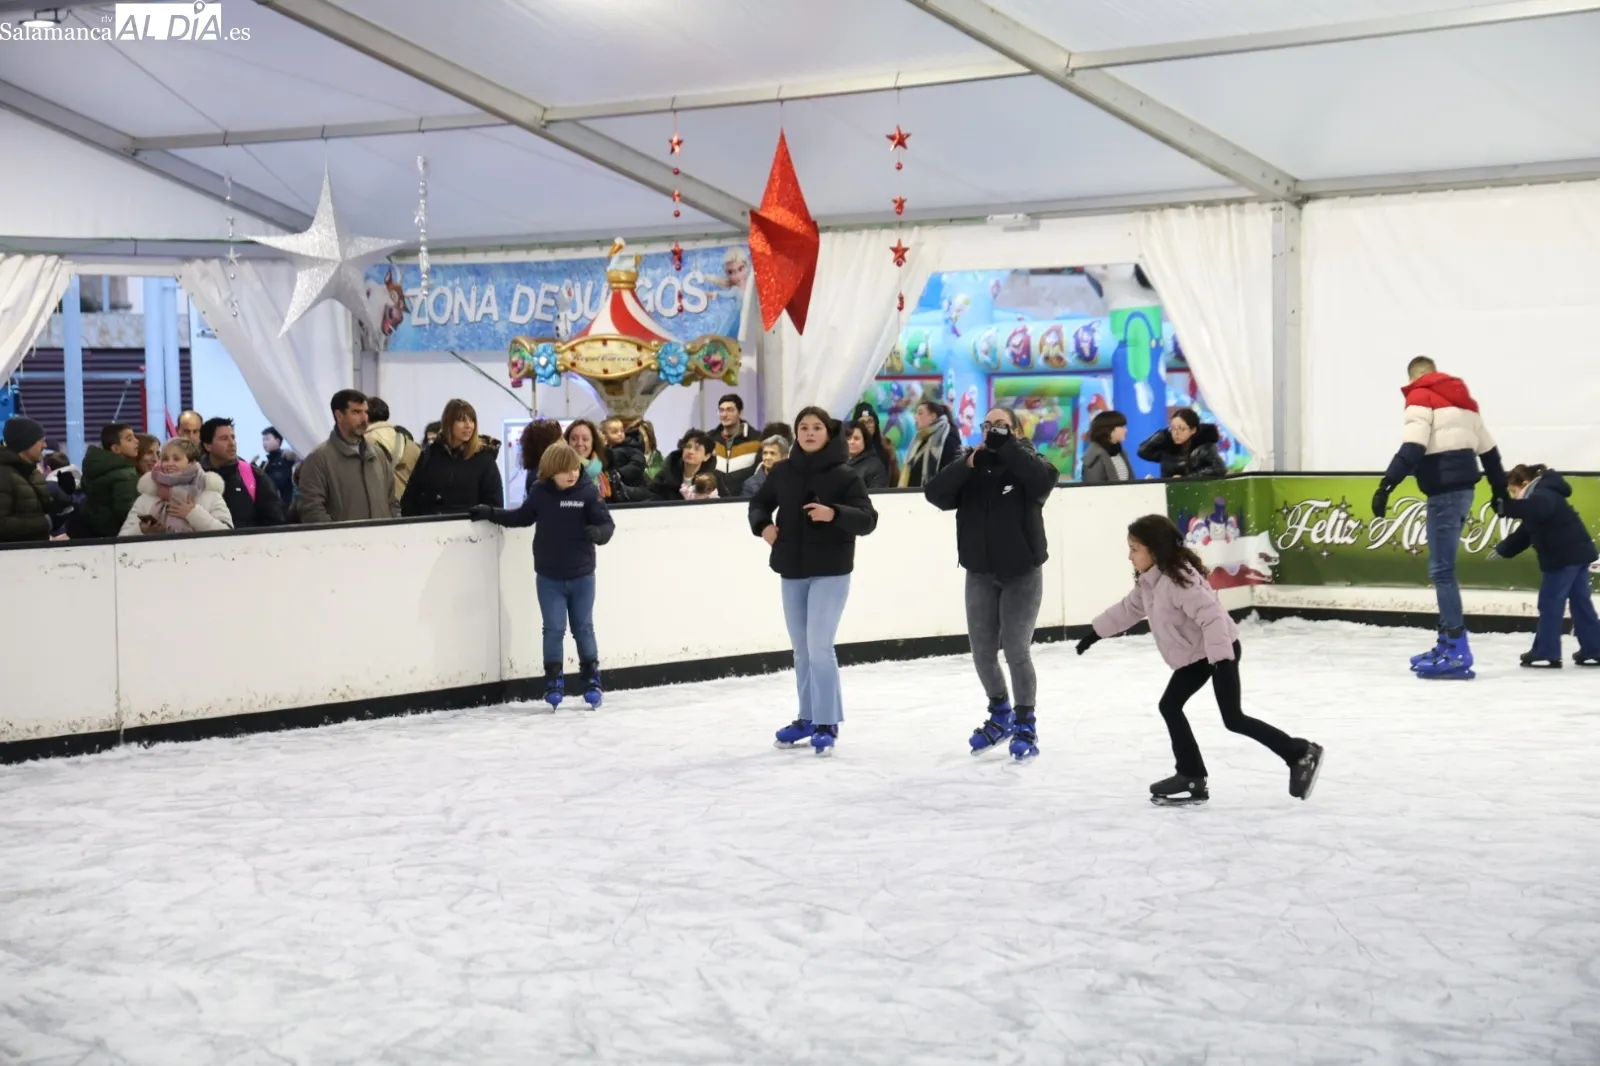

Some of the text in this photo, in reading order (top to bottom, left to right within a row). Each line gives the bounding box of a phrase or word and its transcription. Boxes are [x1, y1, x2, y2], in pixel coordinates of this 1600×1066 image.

[404, 270, 707, 326] ZONA DE JUGOS
[1277, 499, 1360, 550] Feliz
